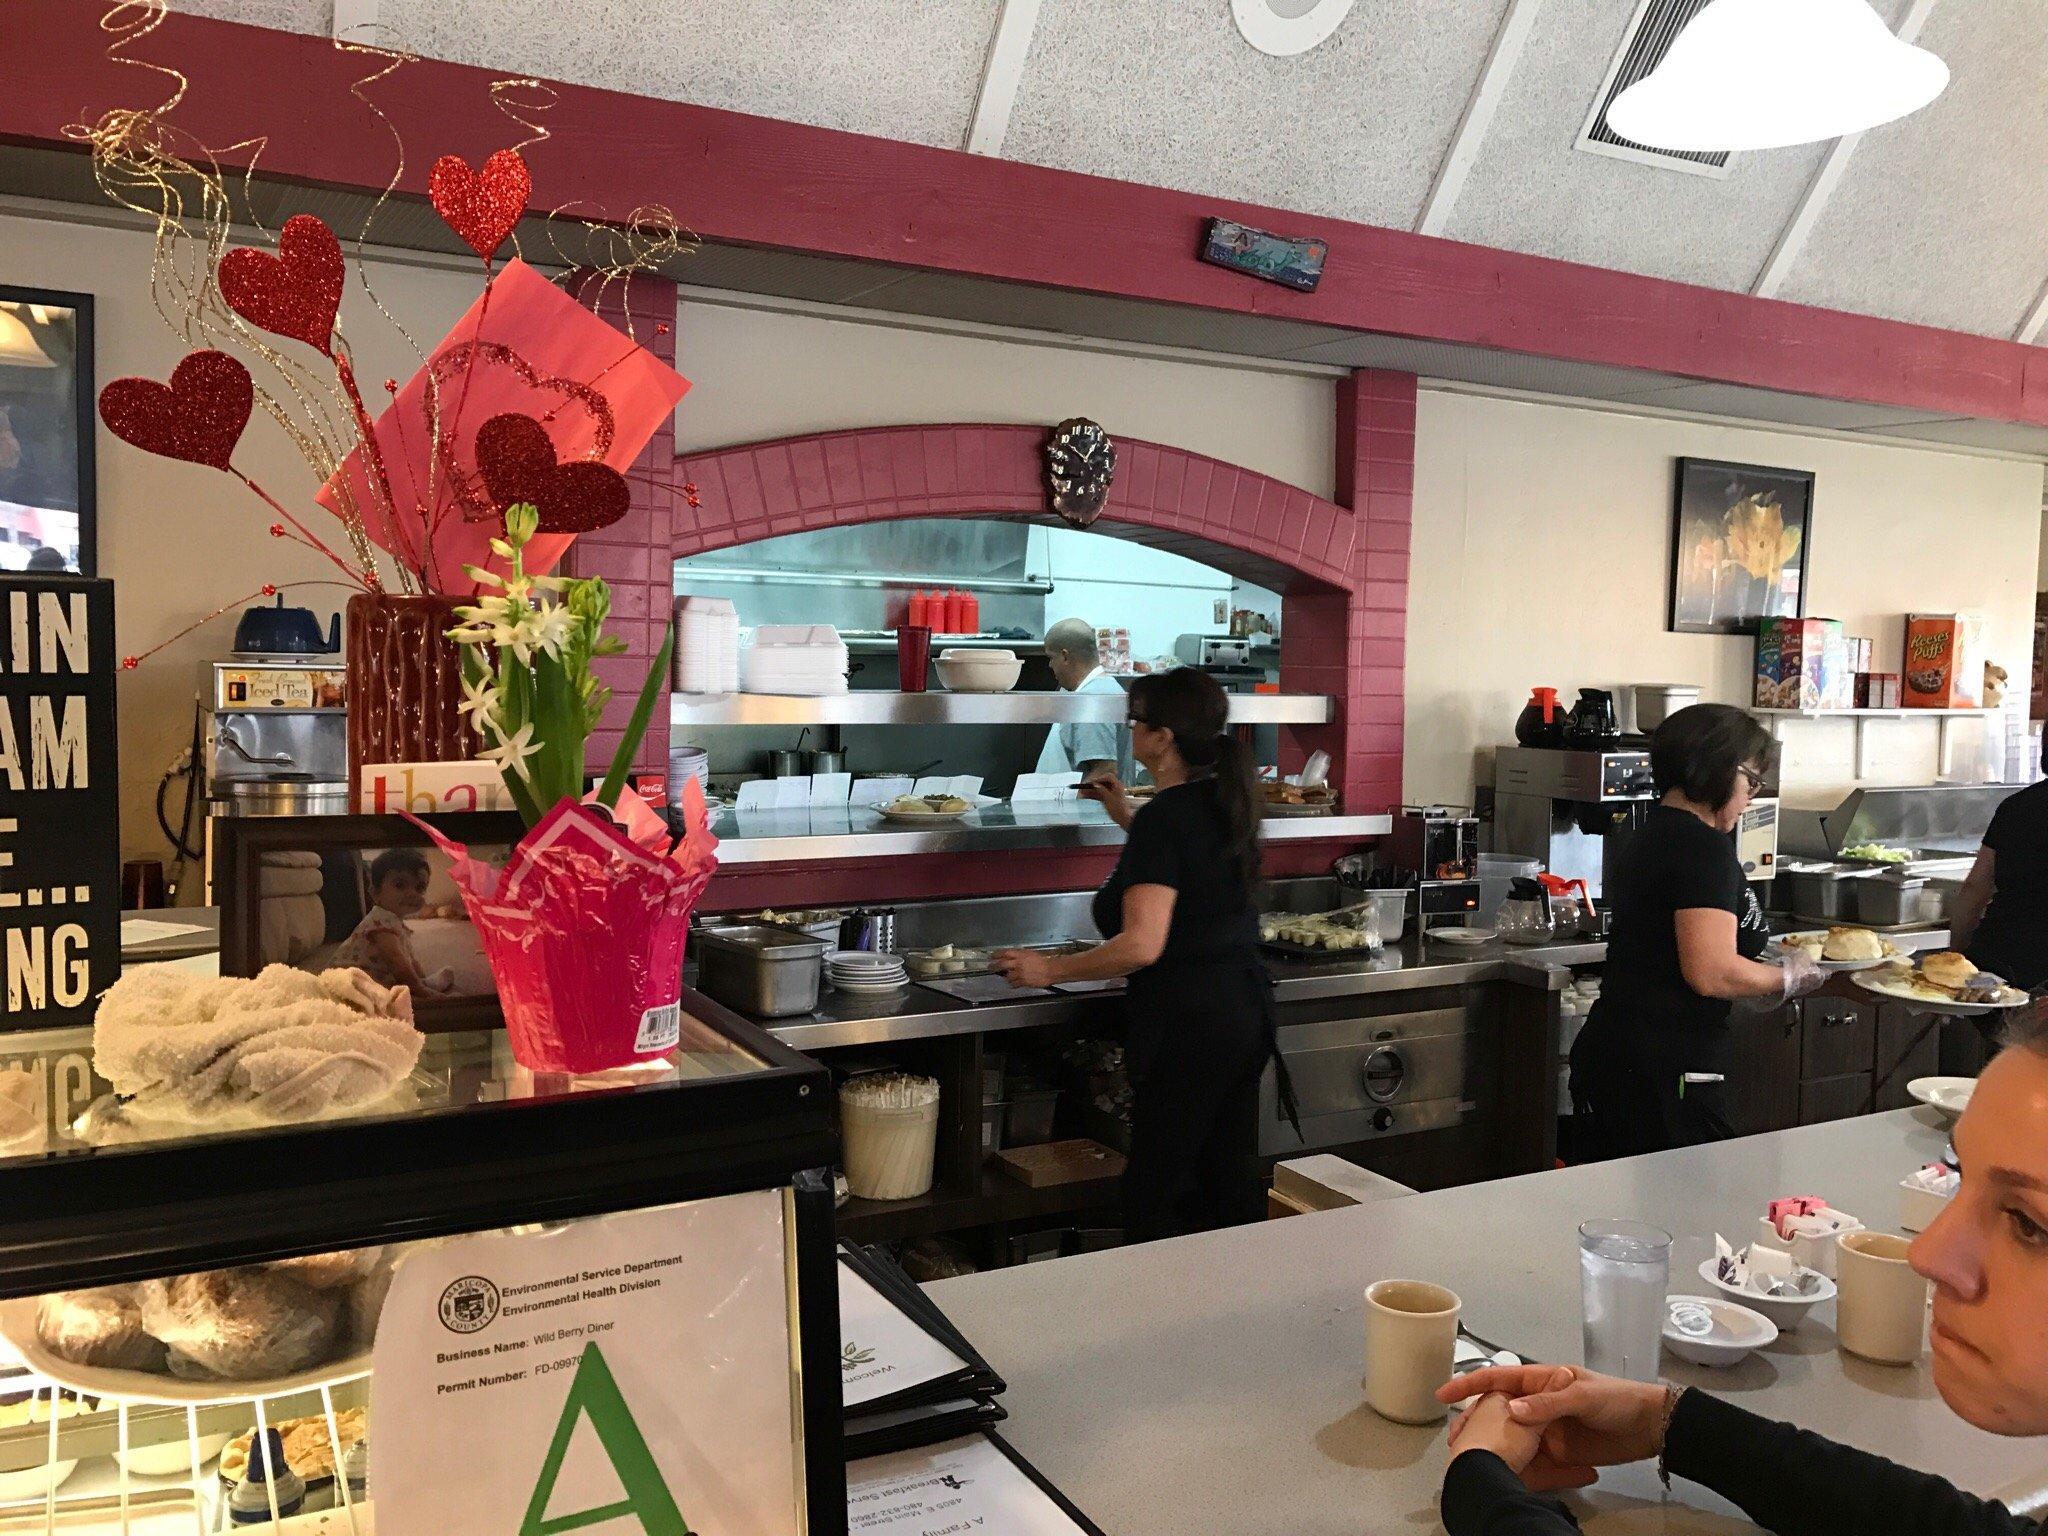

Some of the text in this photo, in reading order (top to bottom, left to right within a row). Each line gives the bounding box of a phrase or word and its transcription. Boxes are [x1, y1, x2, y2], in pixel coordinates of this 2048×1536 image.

[0, 591, 89, 673] IN
[249, 683, 308, 698] Iced Tea
[502, 1255, 683, 1298] Environmental Service Department
[445, 1280, 491, 1300] MARICOPA
[502, 1278, 661, 1317] Environmental Health Division
[450, 1314, 489, 1331] COUNTY
[436, 1321, 615, 1364] Business Name: Wild Berry Diner
[437, 1379, 476, 1395] Permit
[479, 1370, 527, 1387] Number:
[518, 1340, 690, 1536] A
[882, 1478, 940, 1499] Breakfast
[860, 1516, 893, 1529] Street
[895, 1510, 922, 1522] Main
